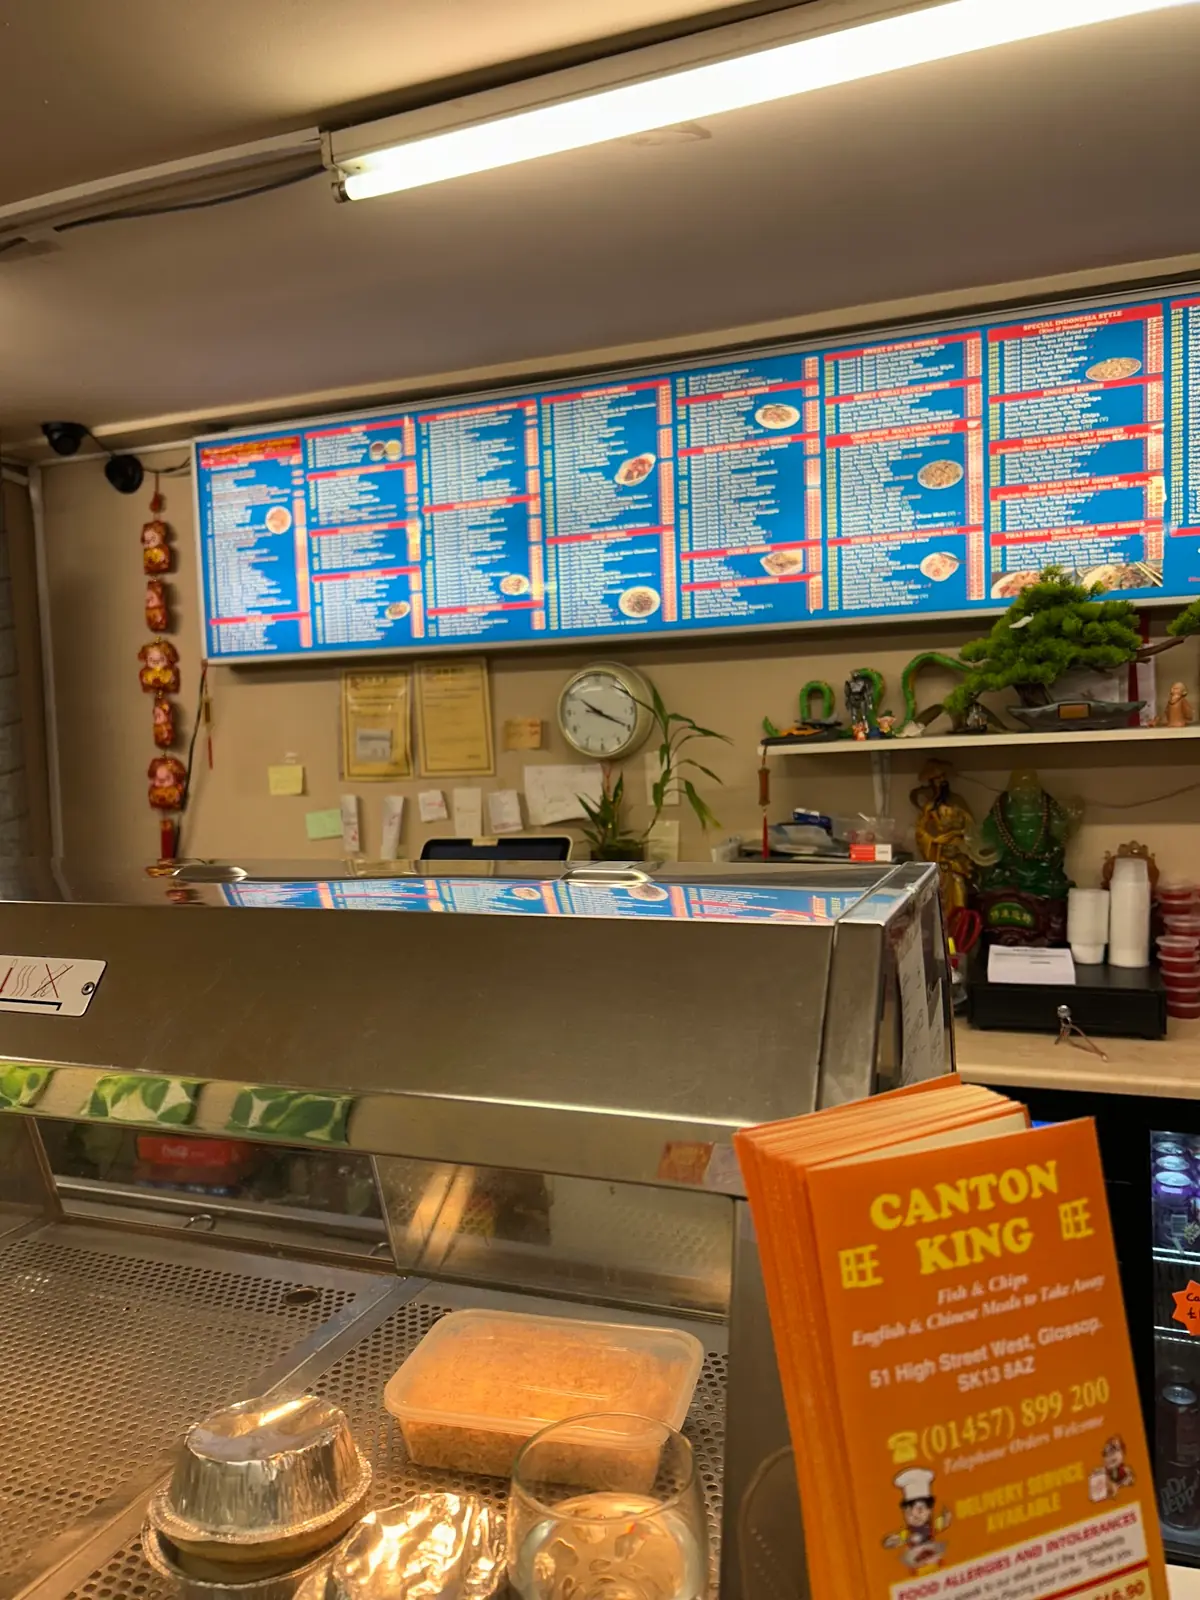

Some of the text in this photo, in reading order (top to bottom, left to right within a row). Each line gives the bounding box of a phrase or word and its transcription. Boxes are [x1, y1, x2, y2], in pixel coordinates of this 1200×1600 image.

[1022, 310, 1122, 330] SPECIAL INDONESIA STYLE
[870, 1160, 1058, 1230] CANTON
[1058, 1198, 1095, 1240] 旺
[839, 1244, 883, 1289] 旺
[916, 1218, 1034, 1274] KING
[852, 1274, 1106, 1347] English & Chinese Meals to Take Away
[937, 1273, 1029, 1306] Fish & Chips
[1186, 1293, 1200, 1302] Ca
[869, 1368, 890, 1388] 51
[895, 1358, 936, 1383] High
[939, 1345, 988, 1372] Street
[990, 1334, 1035, 1356] West,
[958, 1366, 1000, 1392] SK13
[921, 1377, 1110, 1461] (01457) 899 200
[944, 1416, 1104, 1475] Telephone Orders Welcome
[955, 1462, 1084, 1519] DELIVERY SERVICE
[987, 1492, 1062, 1533] AVAILABLE
[898, 1509, 1137, 1600] FOOD ALLERGIES AND INTOLERANCES
